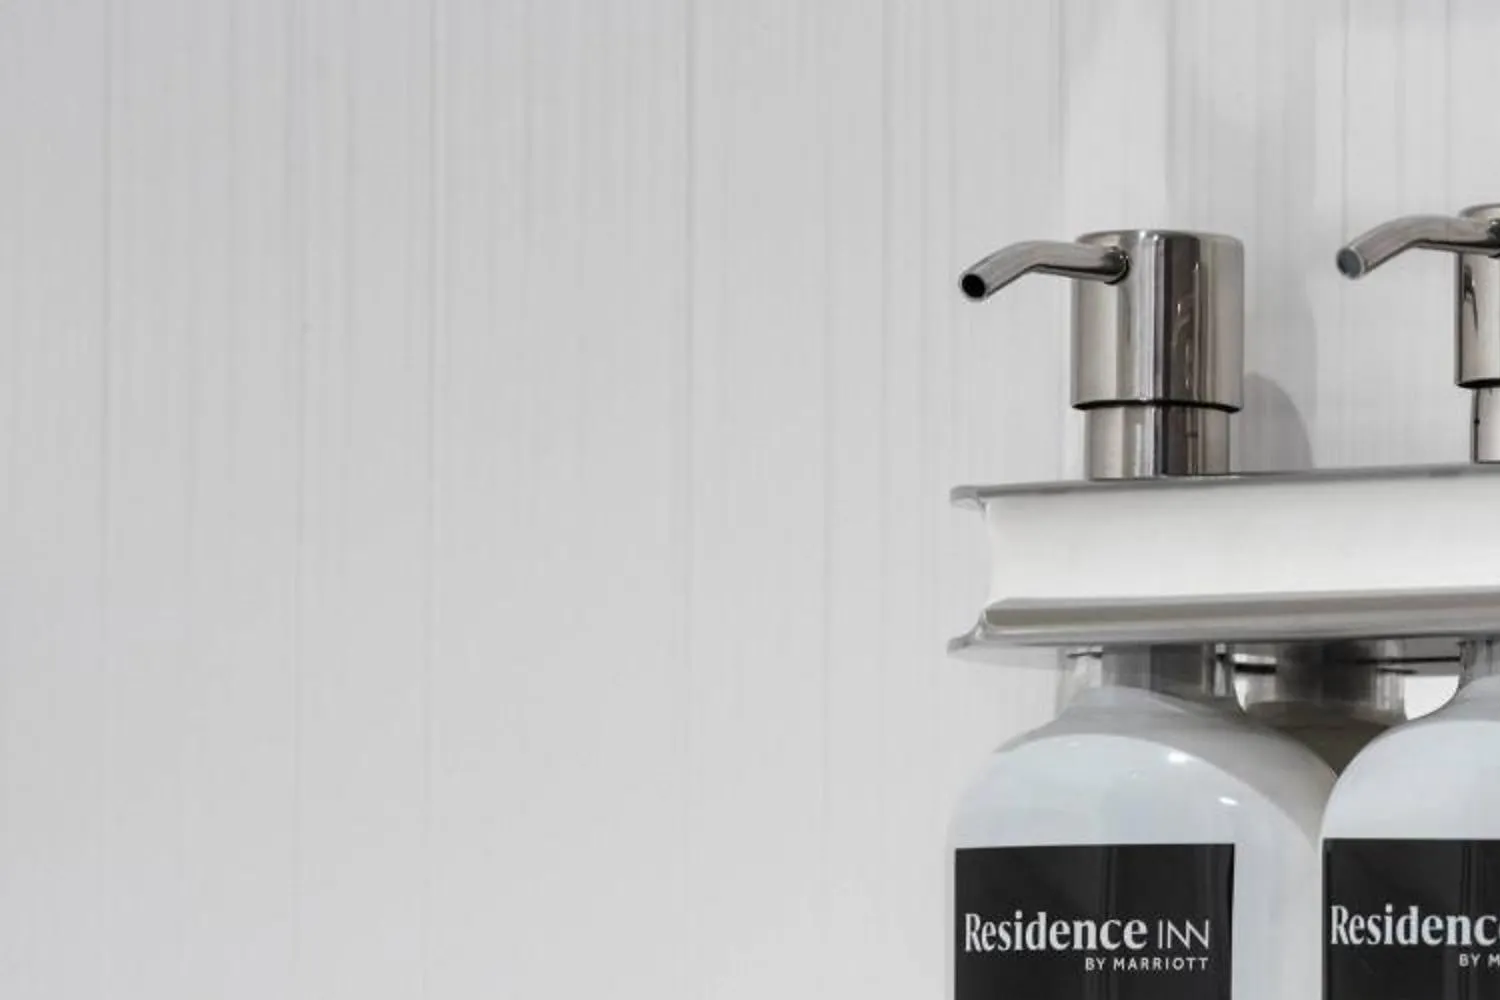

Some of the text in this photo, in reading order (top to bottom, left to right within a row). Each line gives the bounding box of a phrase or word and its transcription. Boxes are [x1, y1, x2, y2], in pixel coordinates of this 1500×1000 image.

[965, 910, 1211, 952] Residence INN
[1085, 957, 1209, 971] BY MARRIOTT
[1459, 953, 1481, 968] BY
